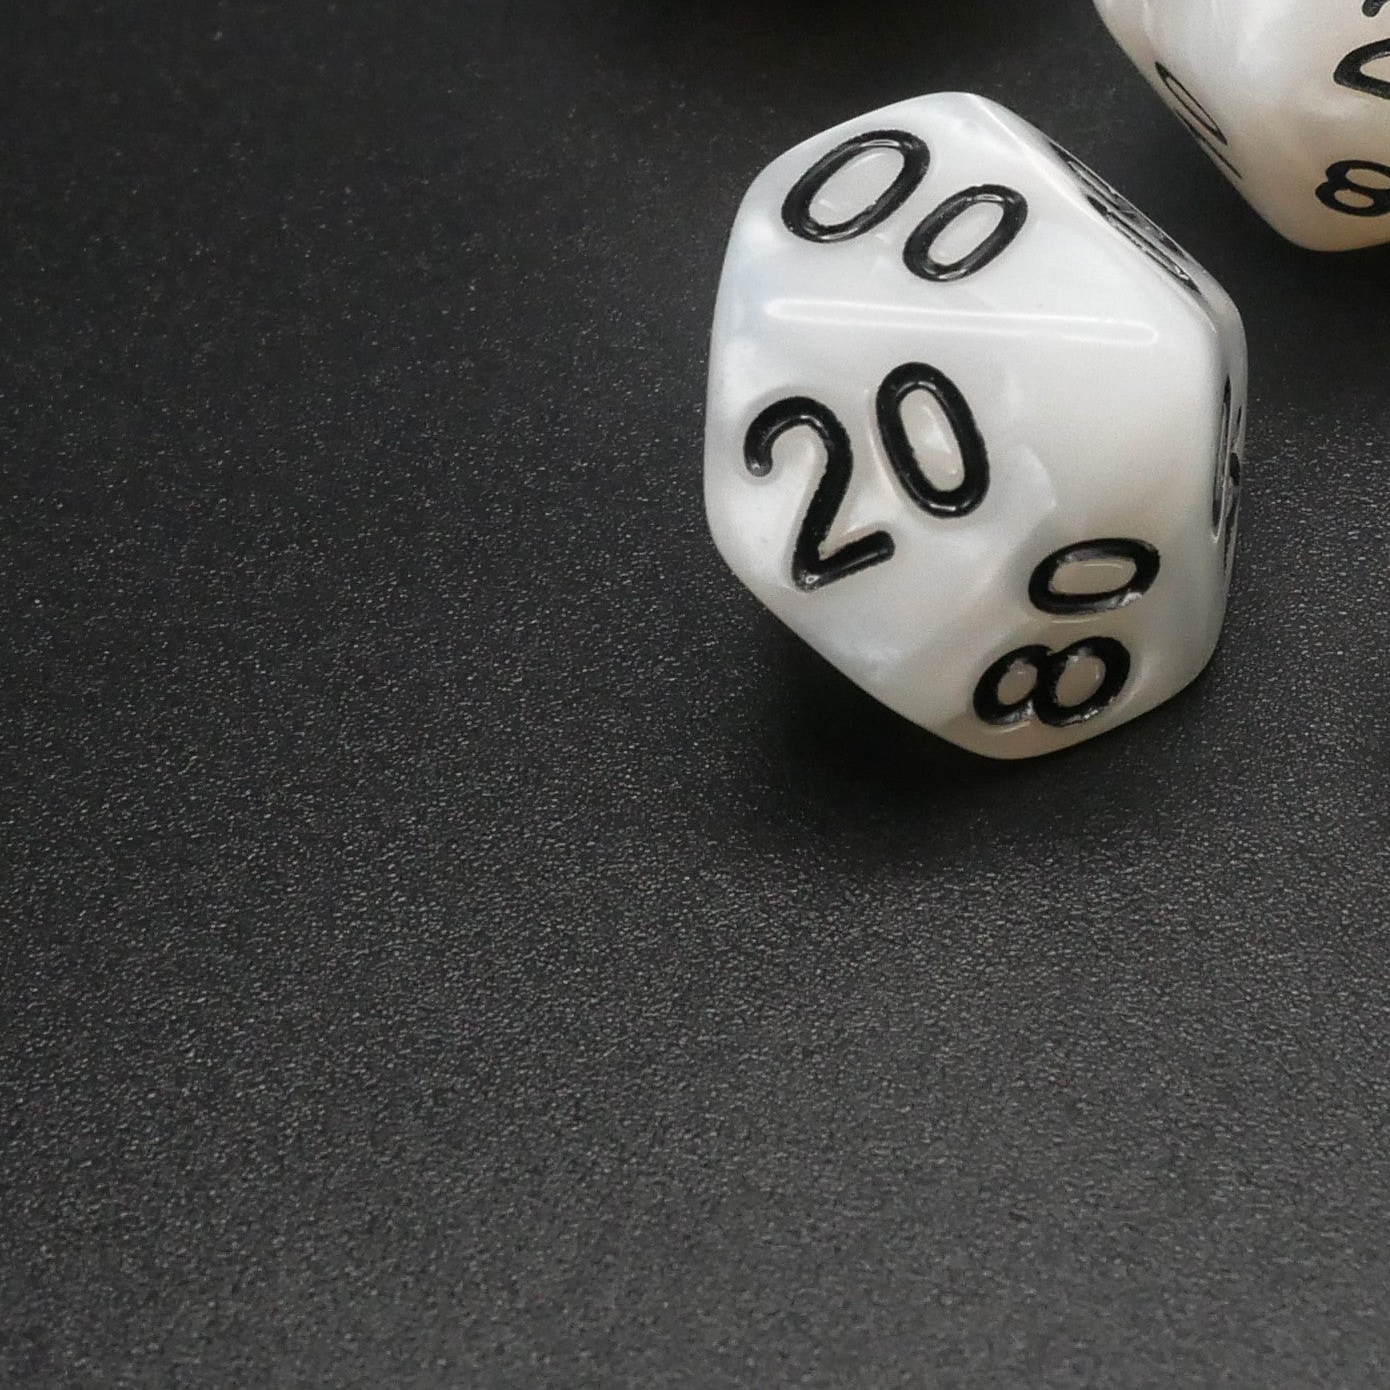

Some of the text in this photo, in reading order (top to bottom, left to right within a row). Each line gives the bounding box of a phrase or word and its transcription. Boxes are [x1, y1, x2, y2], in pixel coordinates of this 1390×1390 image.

[780, 128, 1029, 284] 00
[742, 360, 992, 594] 20
[971, 536, 1163, 729] 80
